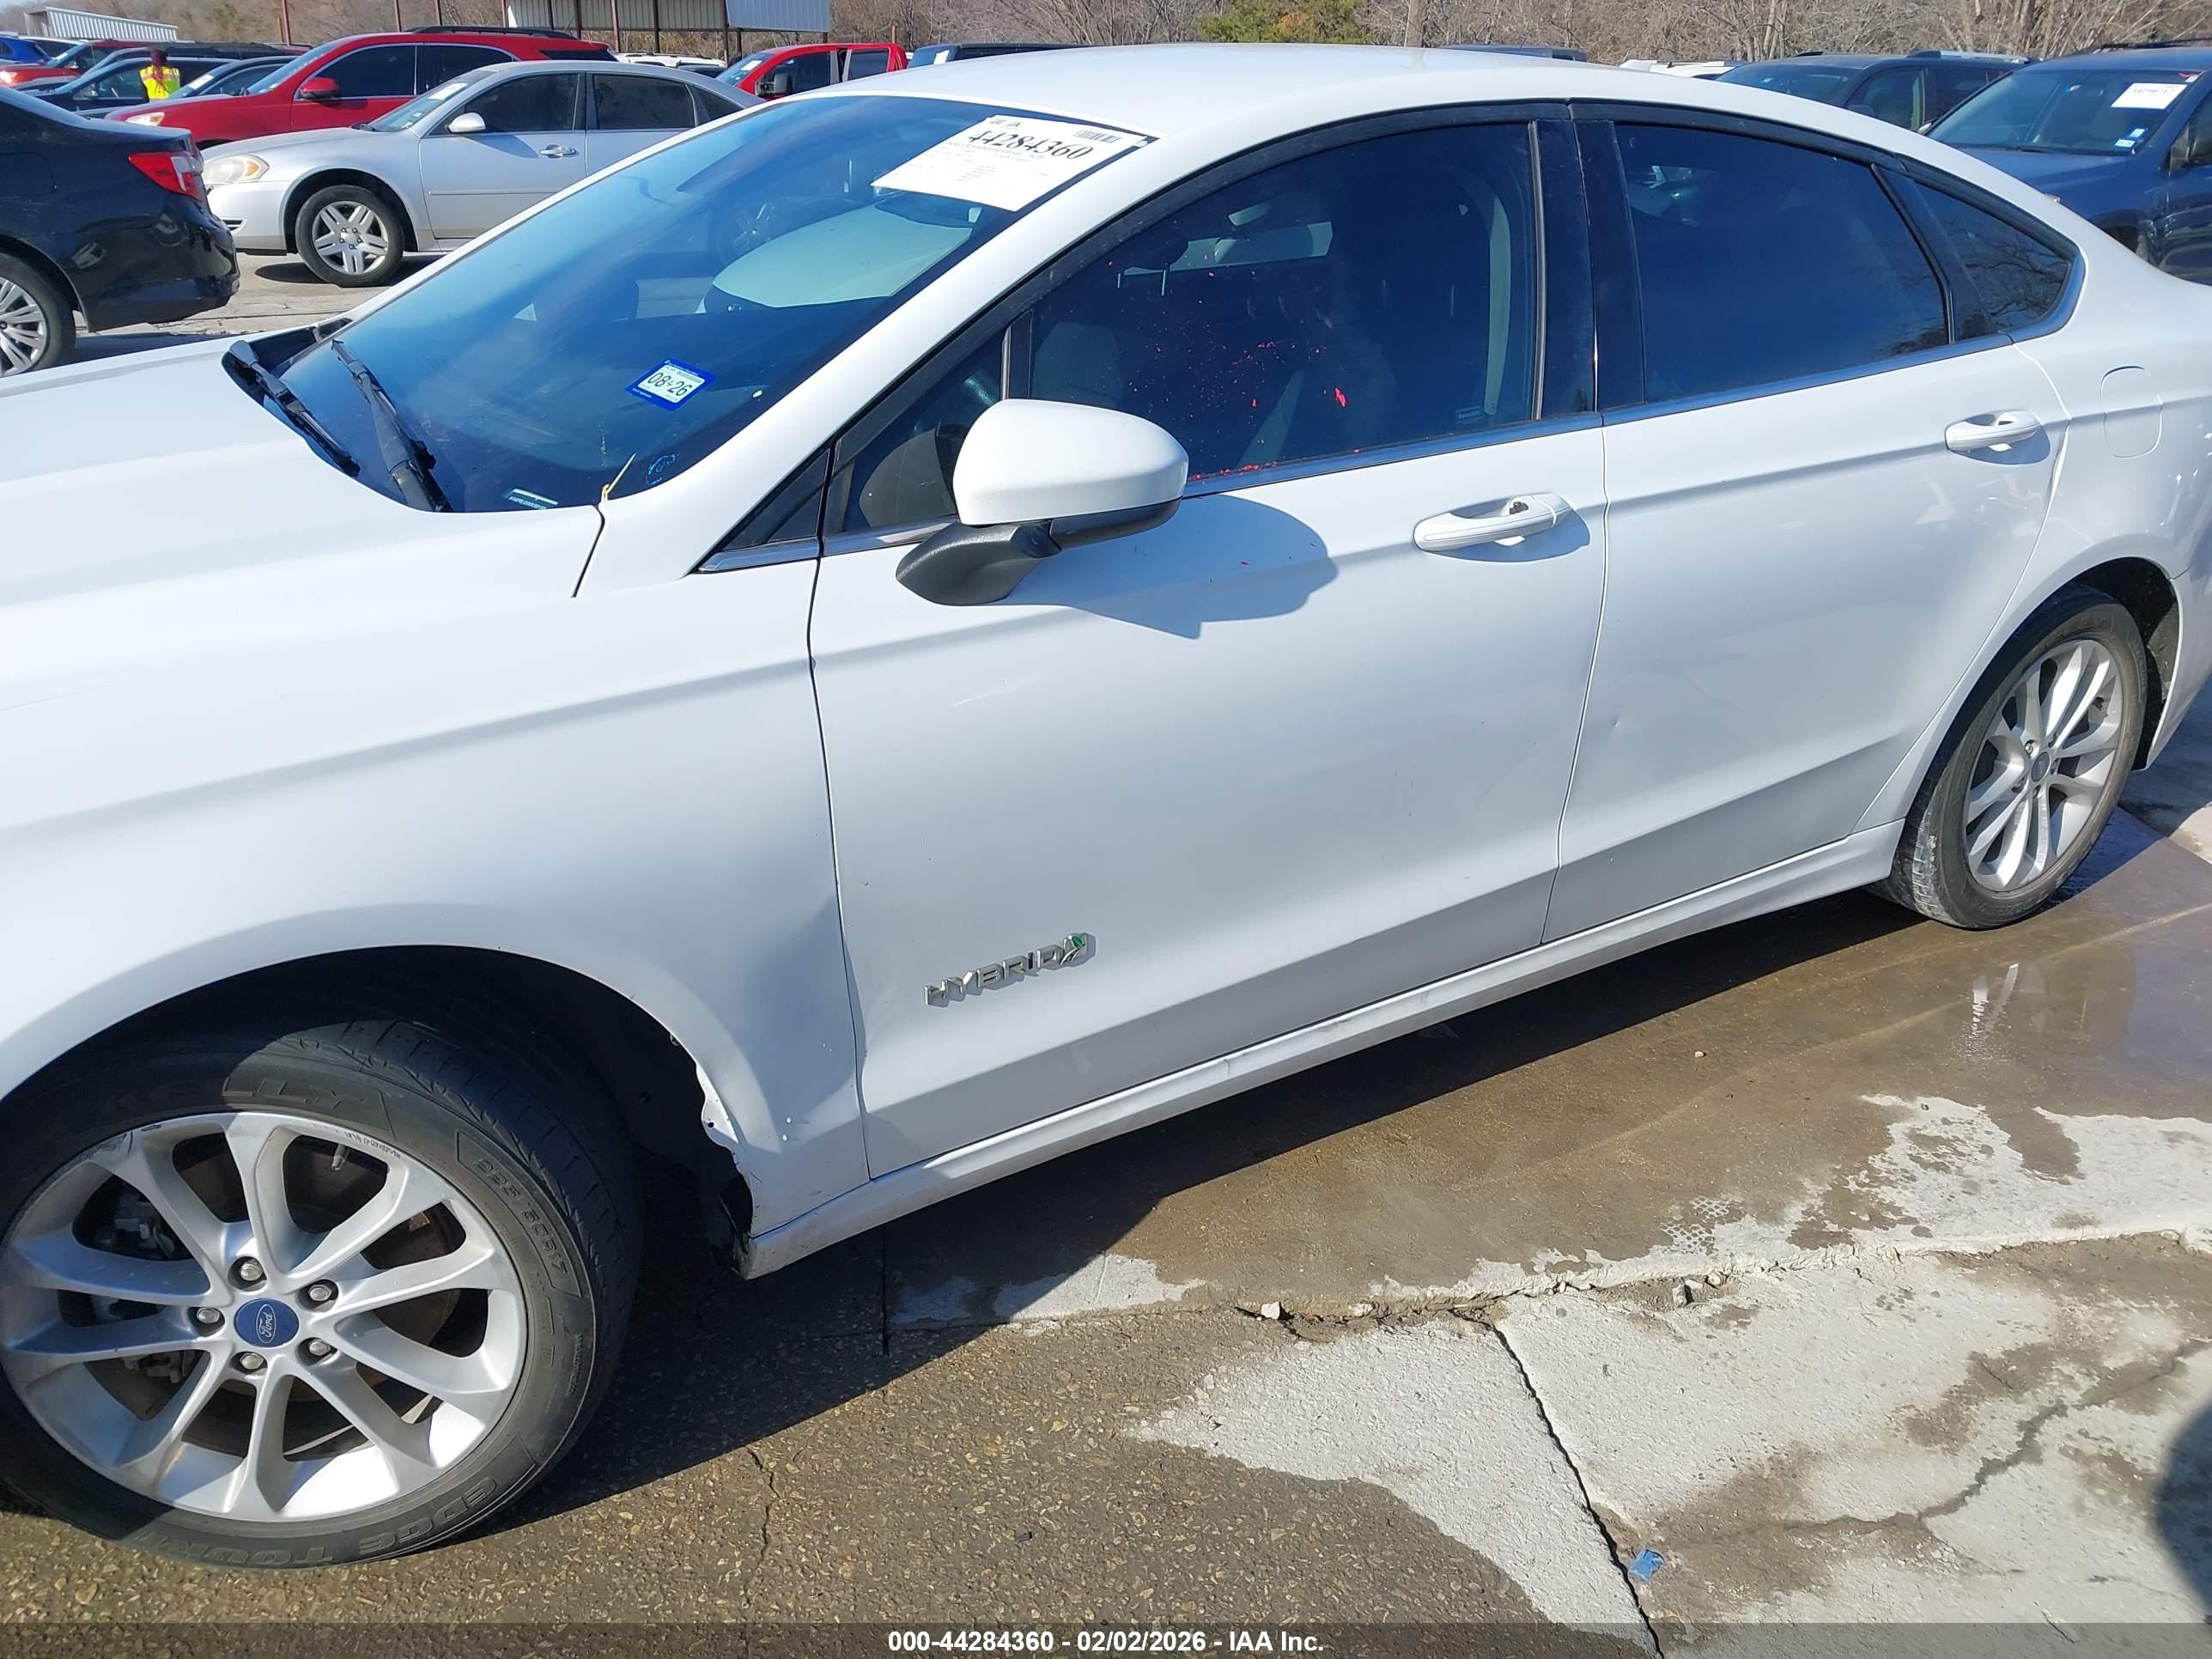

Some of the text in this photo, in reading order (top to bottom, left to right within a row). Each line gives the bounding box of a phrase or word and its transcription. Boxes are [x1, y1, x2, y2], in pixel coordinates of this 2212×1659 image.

[968, 131, 1094, 160] 44284360
[923, 945, 1065, 1006] HYBRID
[258, 1311, 273, 1338] Ford
